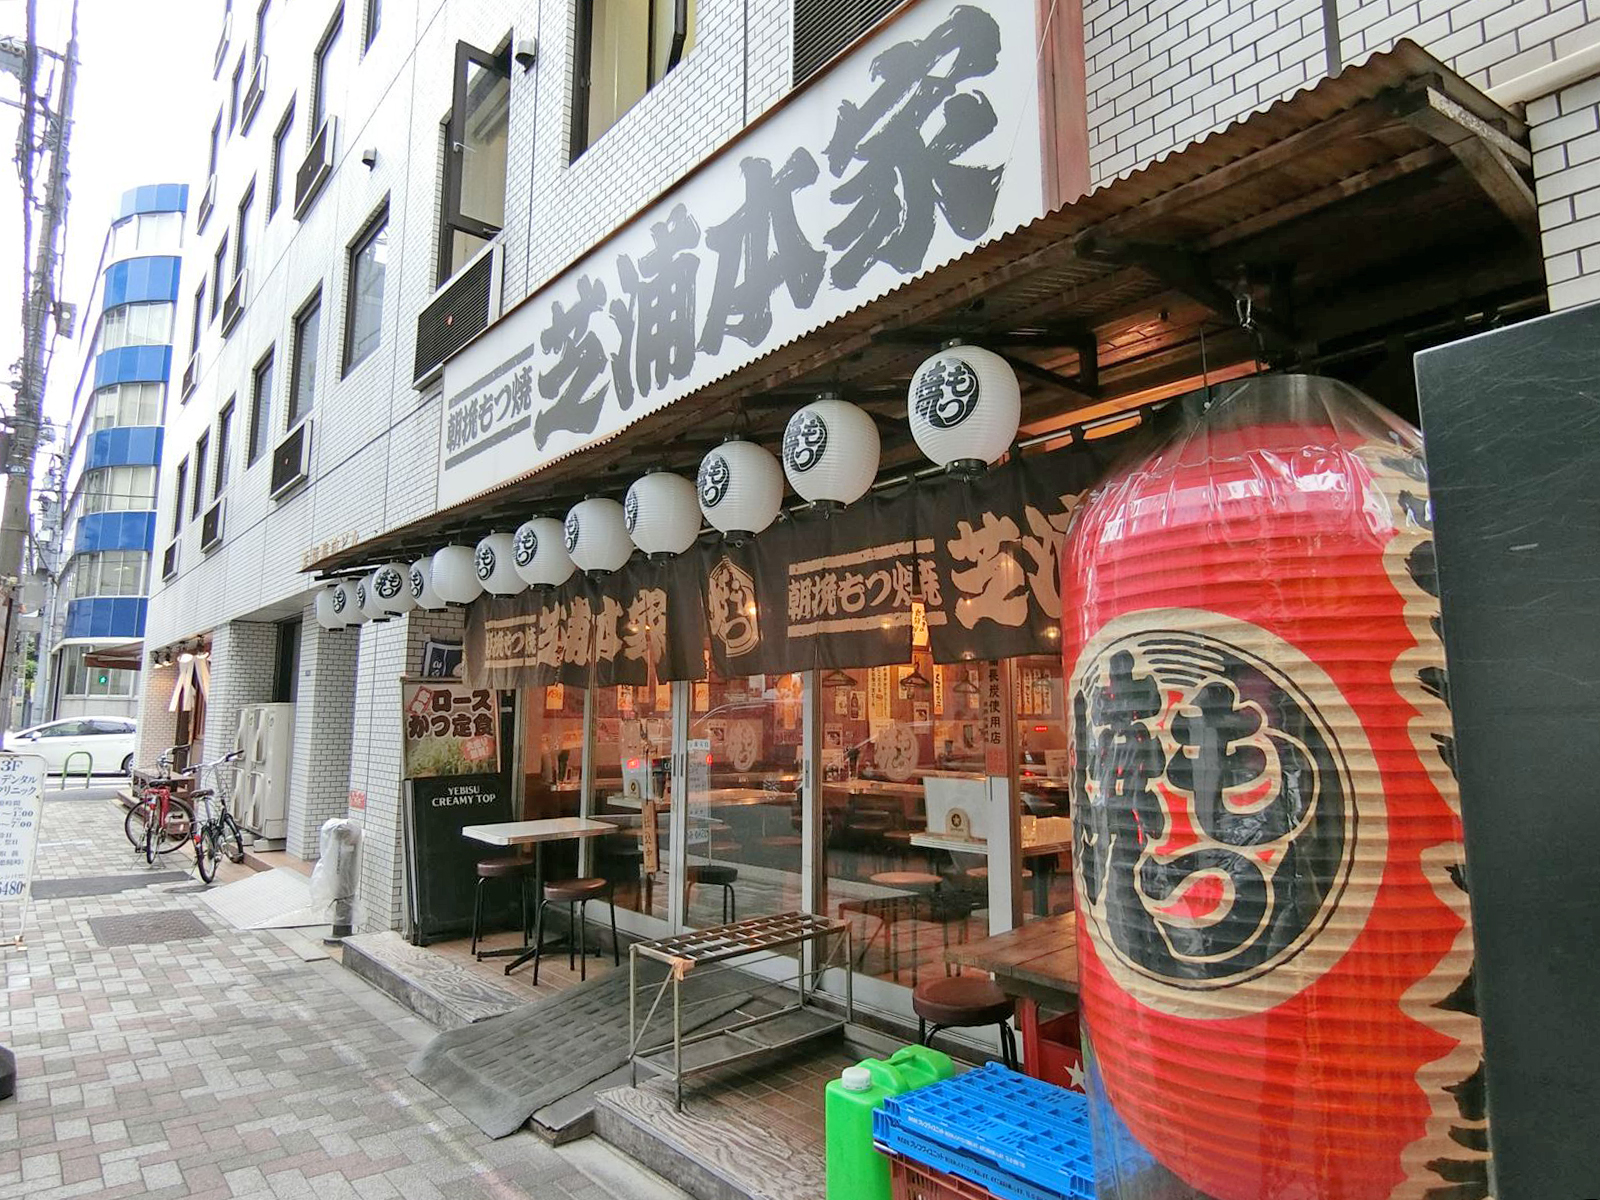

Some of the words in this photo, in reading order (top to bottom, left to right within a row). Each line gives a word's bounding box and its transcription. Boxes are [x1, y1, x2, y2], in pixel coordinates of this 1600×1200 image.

[533, 4, 1006, 451] 芝浦本家
[432, 689, 492, 713] ロース
[408, 713, 494, 738] かつ定食
[0, 760, 23, 772] 3F
[0, 774, 37, 785] デンタル
[448, 785, 480, 796] YEBISU
[431, 797, 475, 808] CREAMY
[477, 793, 496, 804] TOP
